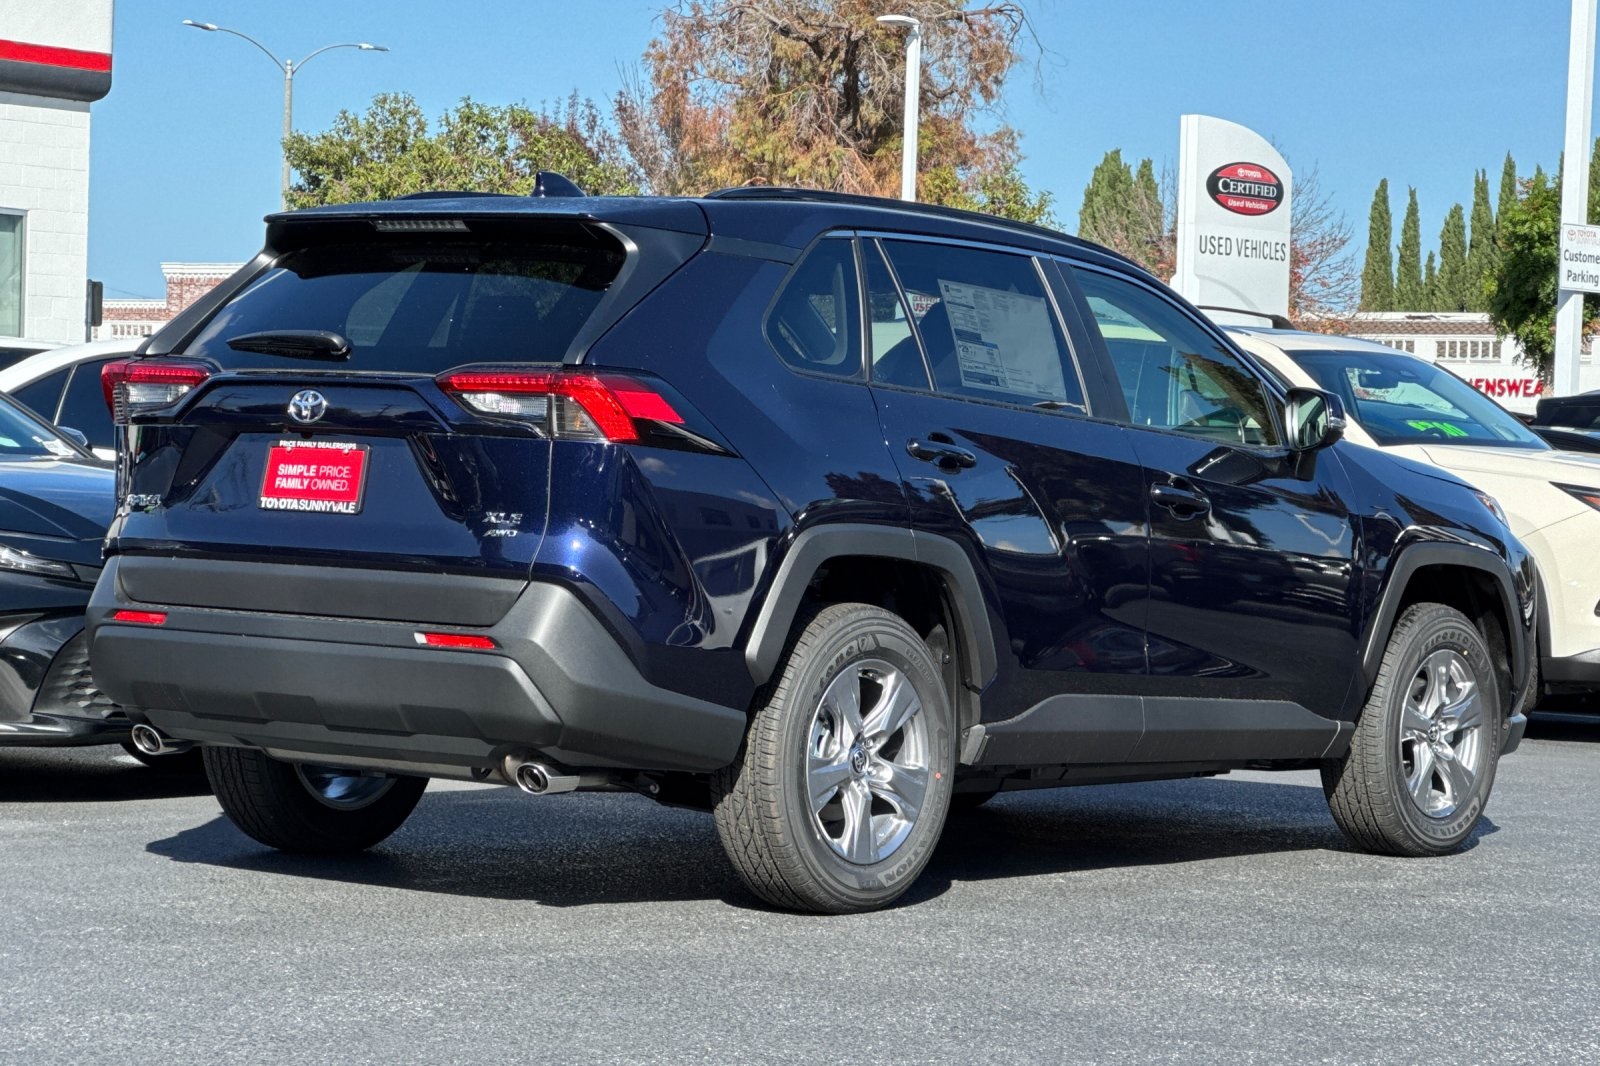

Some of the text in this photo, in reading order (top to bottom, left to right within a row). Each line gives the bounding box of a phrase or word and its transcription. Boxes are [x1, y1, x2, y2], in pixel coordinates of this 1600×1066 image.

[1218, 178, 1277, 198] CERTIFIED
[1228, 199, 1268, 210] Used Vehicles
[1199, 235, 1287, 262] USED VEHICLES
[1567, 270, 1600, 287] Parking
[1468, 378, 1544, 398] ENSWEA
[278, 464, 317, 476] SIMPLE
[275, 478, 309, 490] FAMILY
[482, 511, 523, 525] XLE
